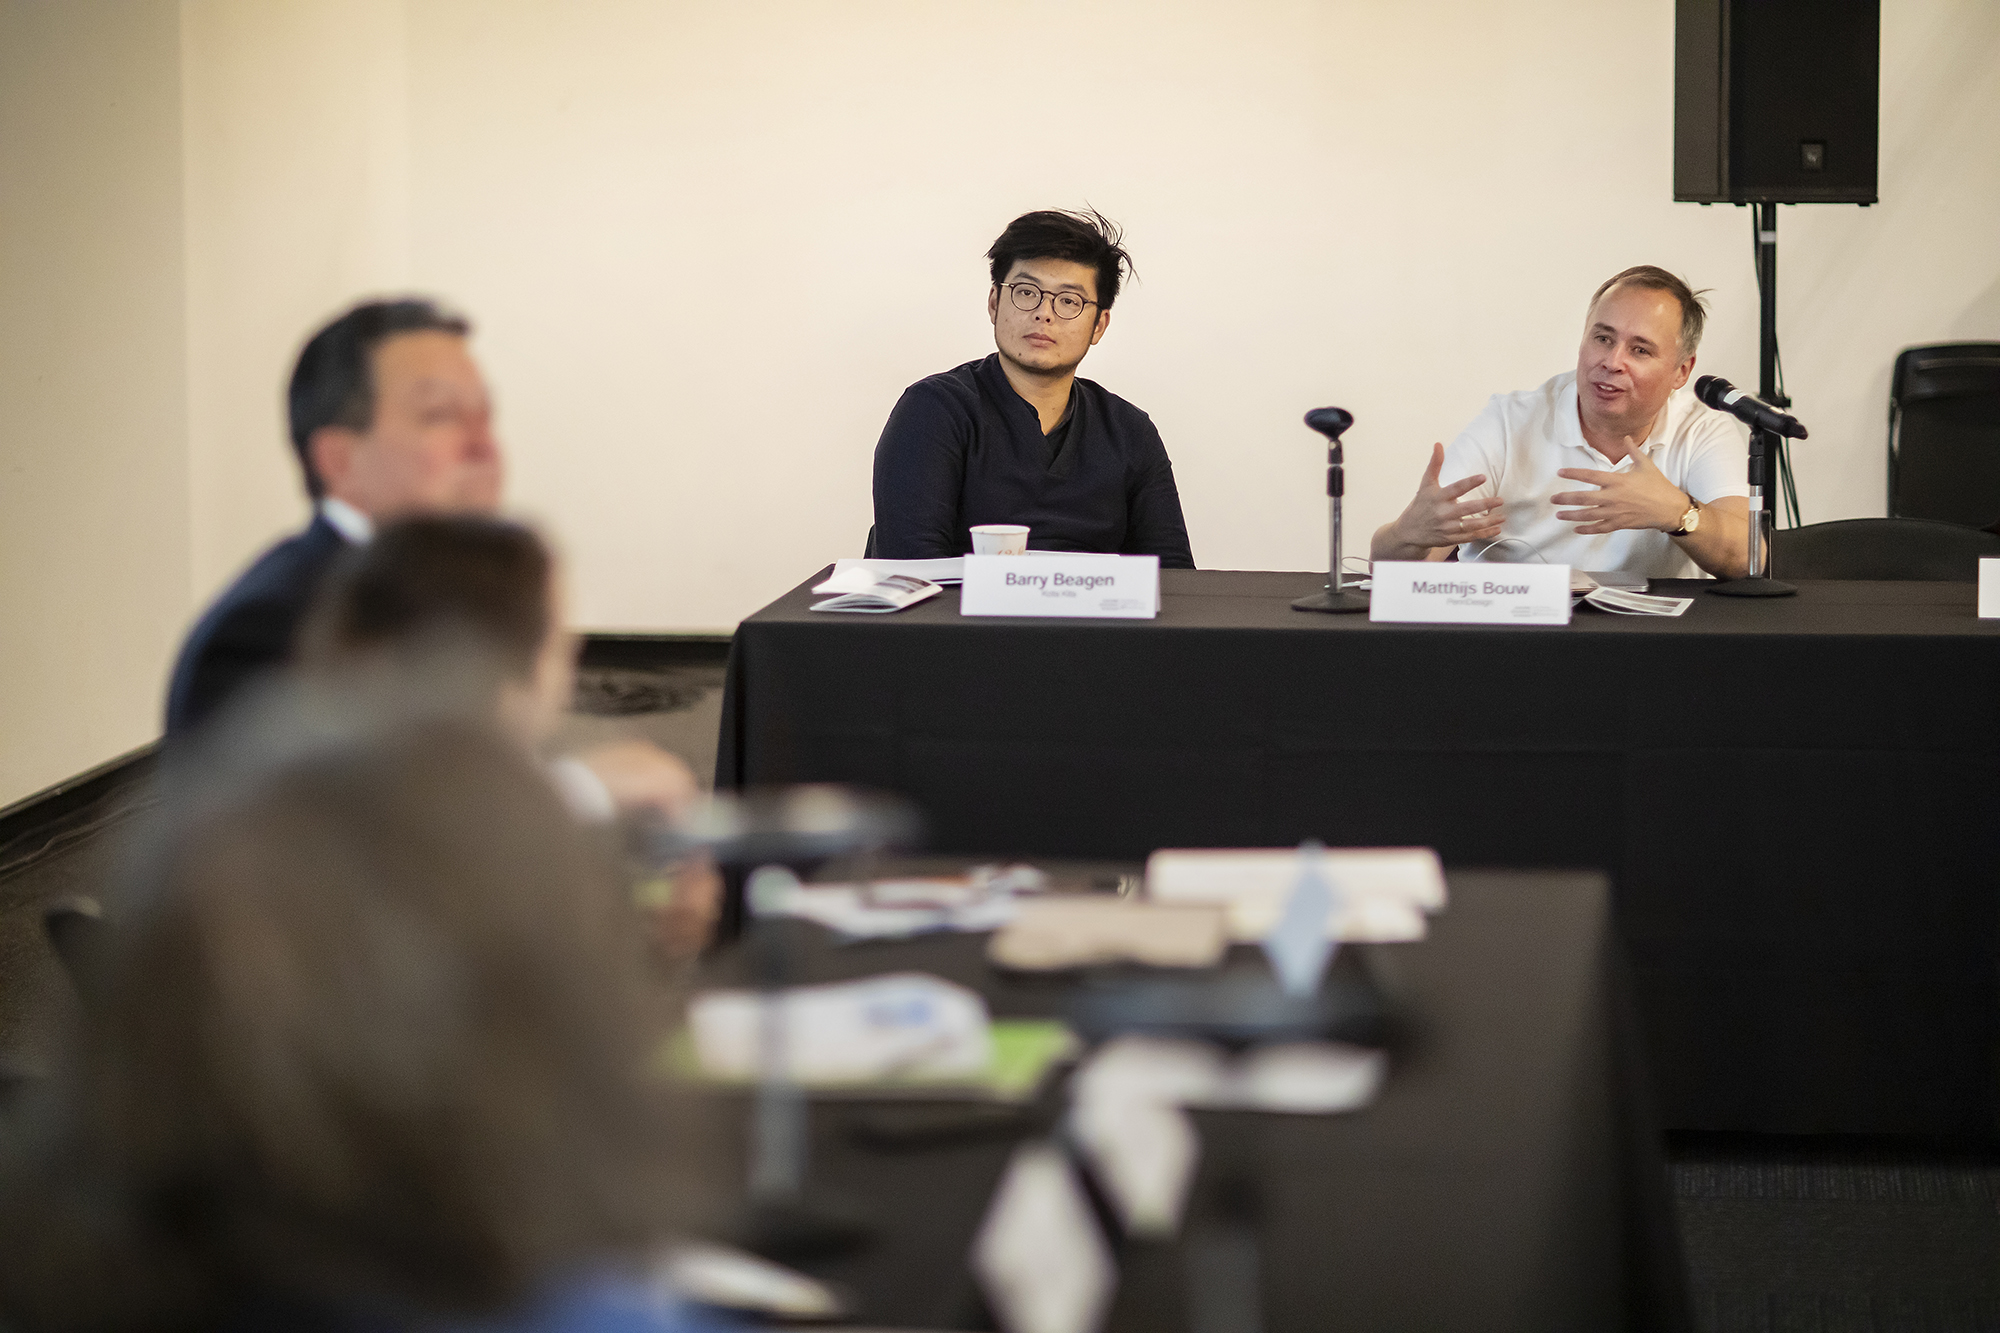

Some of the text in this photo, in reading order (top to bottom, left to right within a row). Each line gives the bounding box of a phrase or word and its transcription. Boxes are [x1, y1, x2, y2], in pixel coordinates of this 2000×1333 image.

[1005, 572, 1115, 590] Barry Beagen
[1411, 580, 1530, 598] Matthijs Bouw
